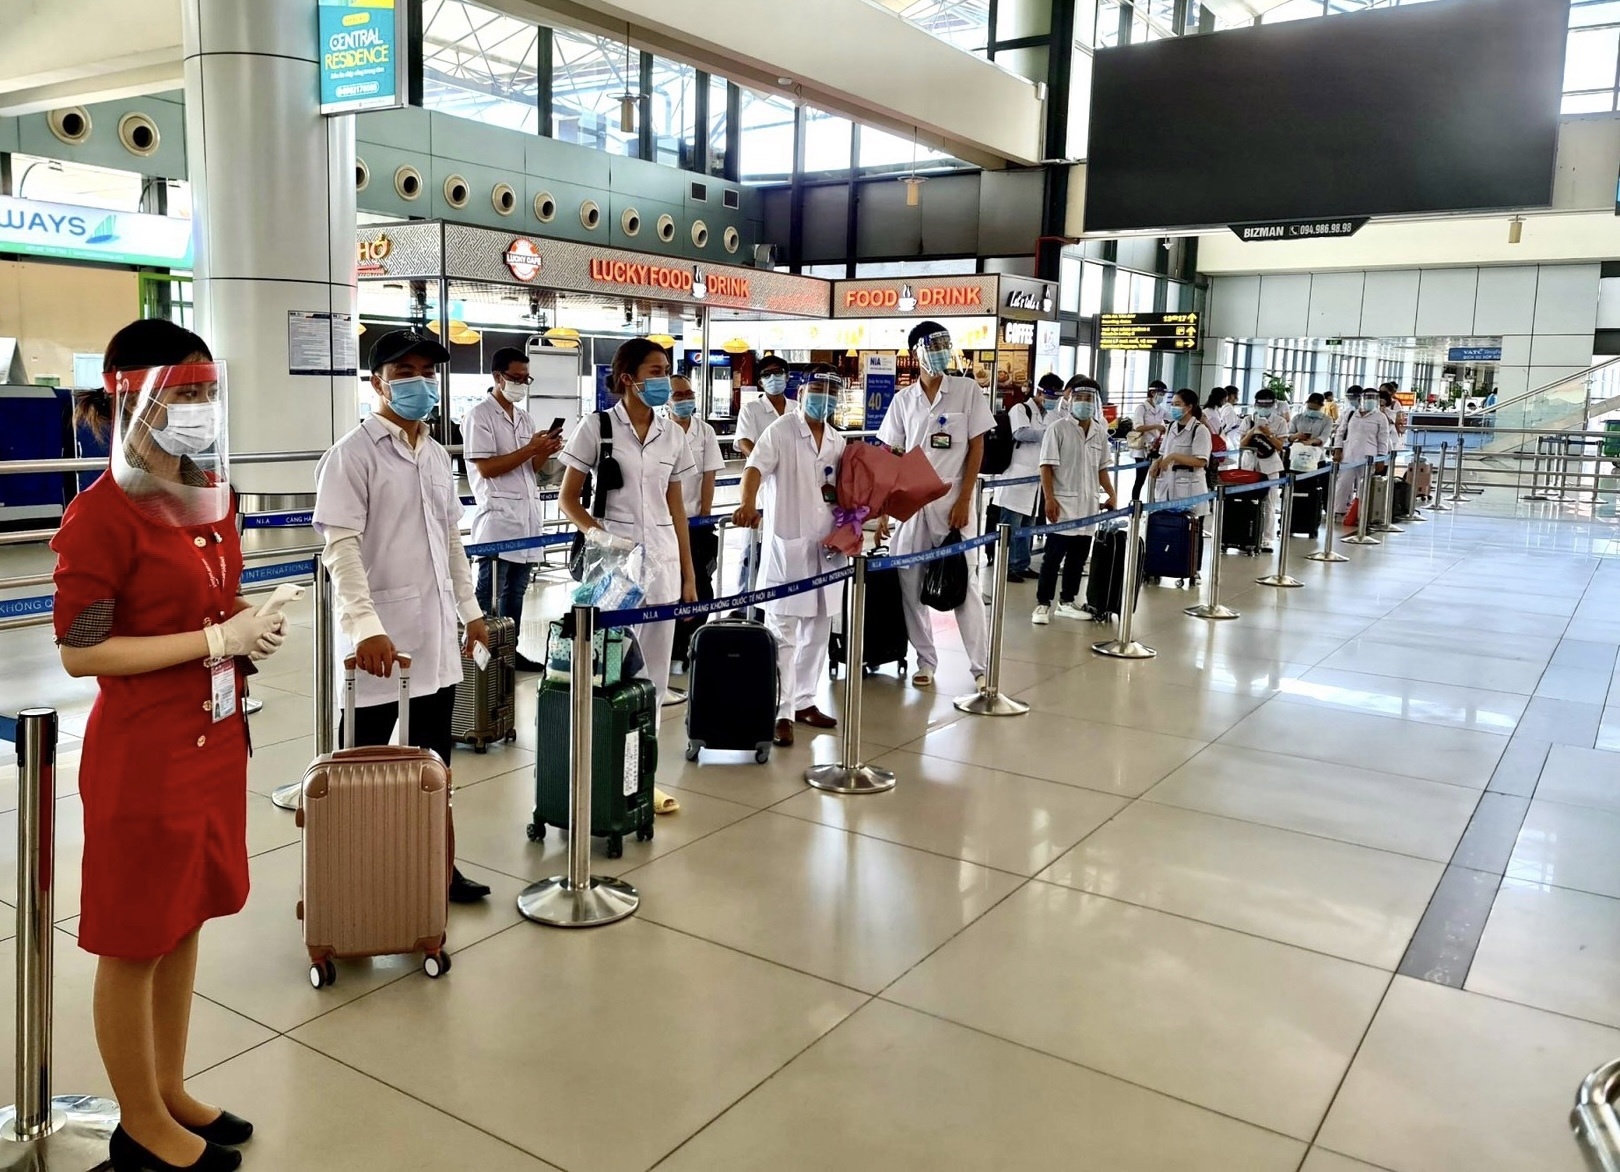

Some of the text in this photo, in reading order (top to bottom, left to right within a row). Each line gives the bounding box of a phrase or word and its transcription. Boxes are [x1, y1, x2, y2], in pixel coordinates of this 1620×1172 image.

[330, 27, 384, 51] CENTRAL
[325, 44, 389, 70] RESIDENCE
[1243, 222, 1352, 238] BIZMAN 094.986.98.98
[357, 231, 389, 261] HỞ
[590, 258, 750, 298] LUCKY FOOD DRINK
[845, 286, 981, 308] FOOD DRINK
[1005, 321, 1035, 345] COFFEE
[868, 392, 882, 411] 40
[246, 563, 313, 579] INTERNATIONAL
[643, 611, 658, 620] N.I.A
